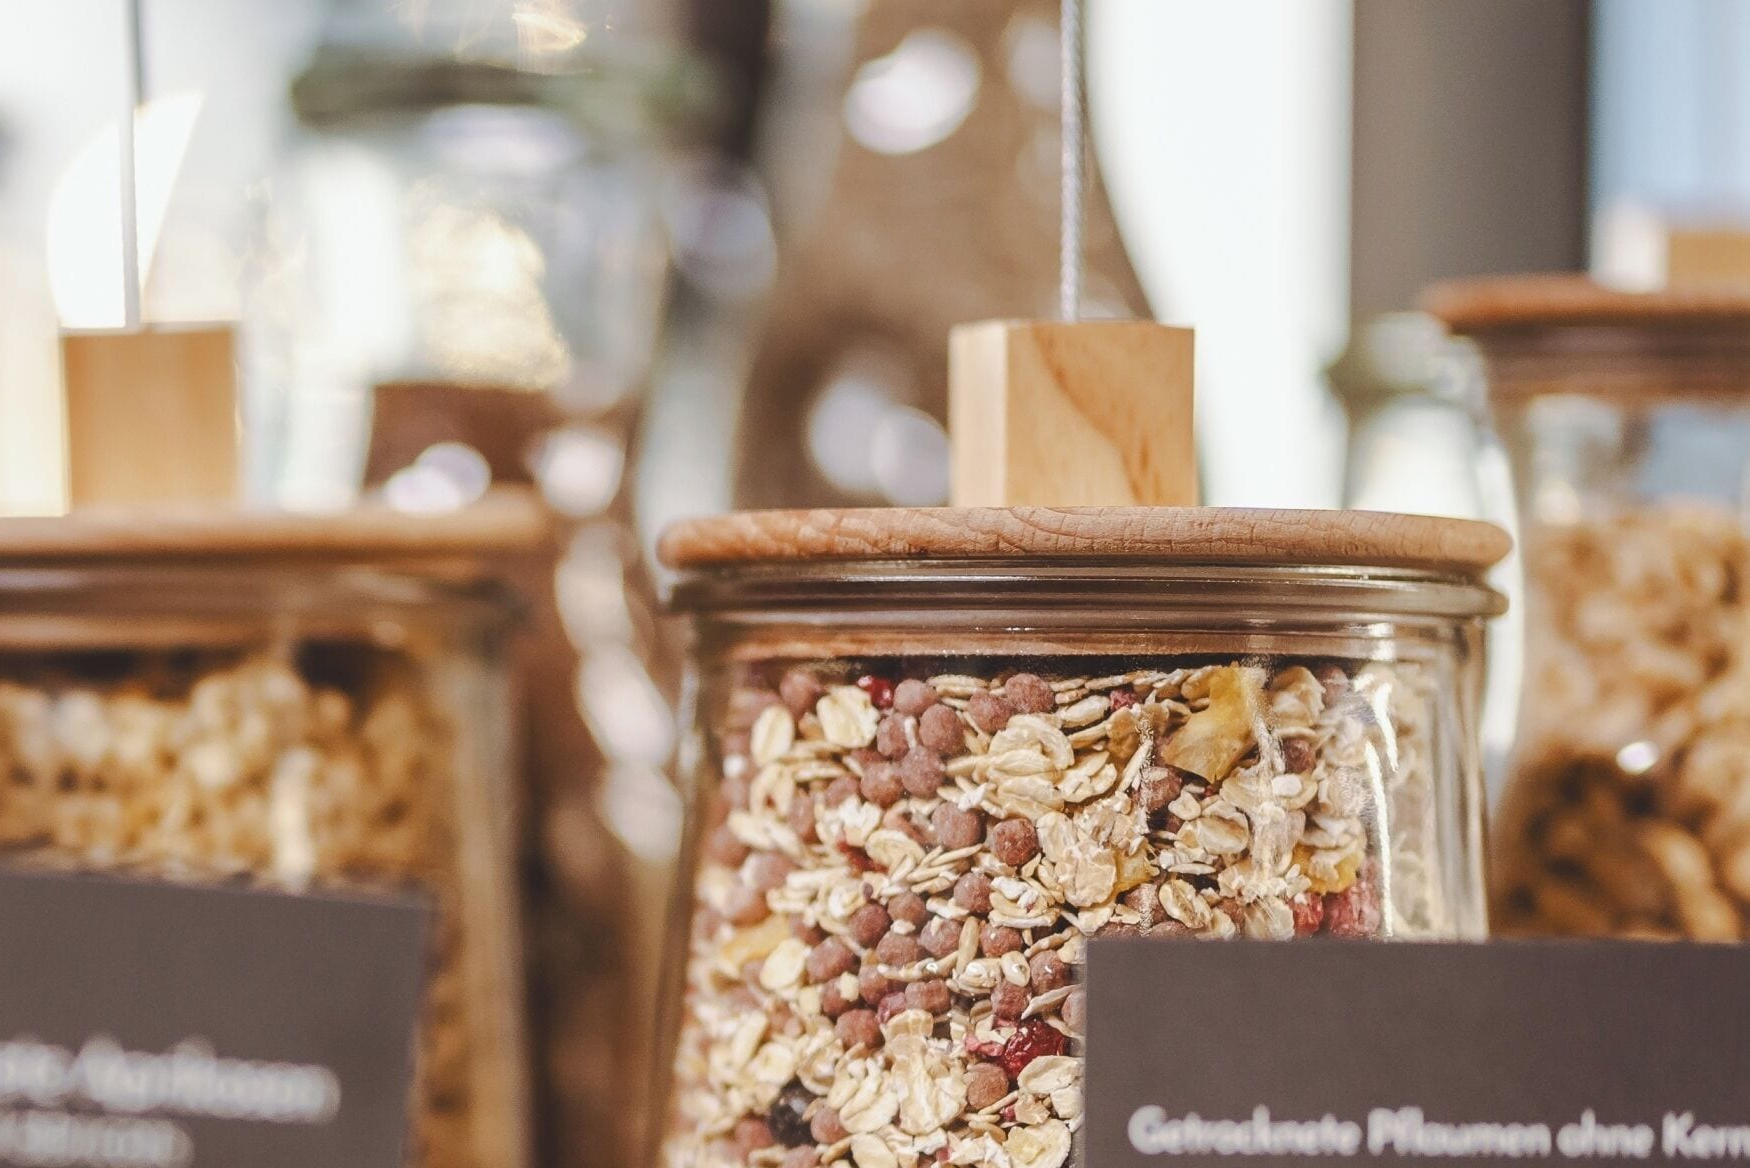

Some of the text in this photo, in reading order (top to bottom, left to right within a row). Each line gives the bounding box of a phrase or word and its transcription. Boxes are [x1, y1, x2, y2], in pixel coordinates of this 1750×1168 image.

[1128, 1105, 1362, 1156] Getrocknete
[1367, 1107, 1551, 1156] Pflaumen
[1557, 1111, 1654, 1157] ohne
